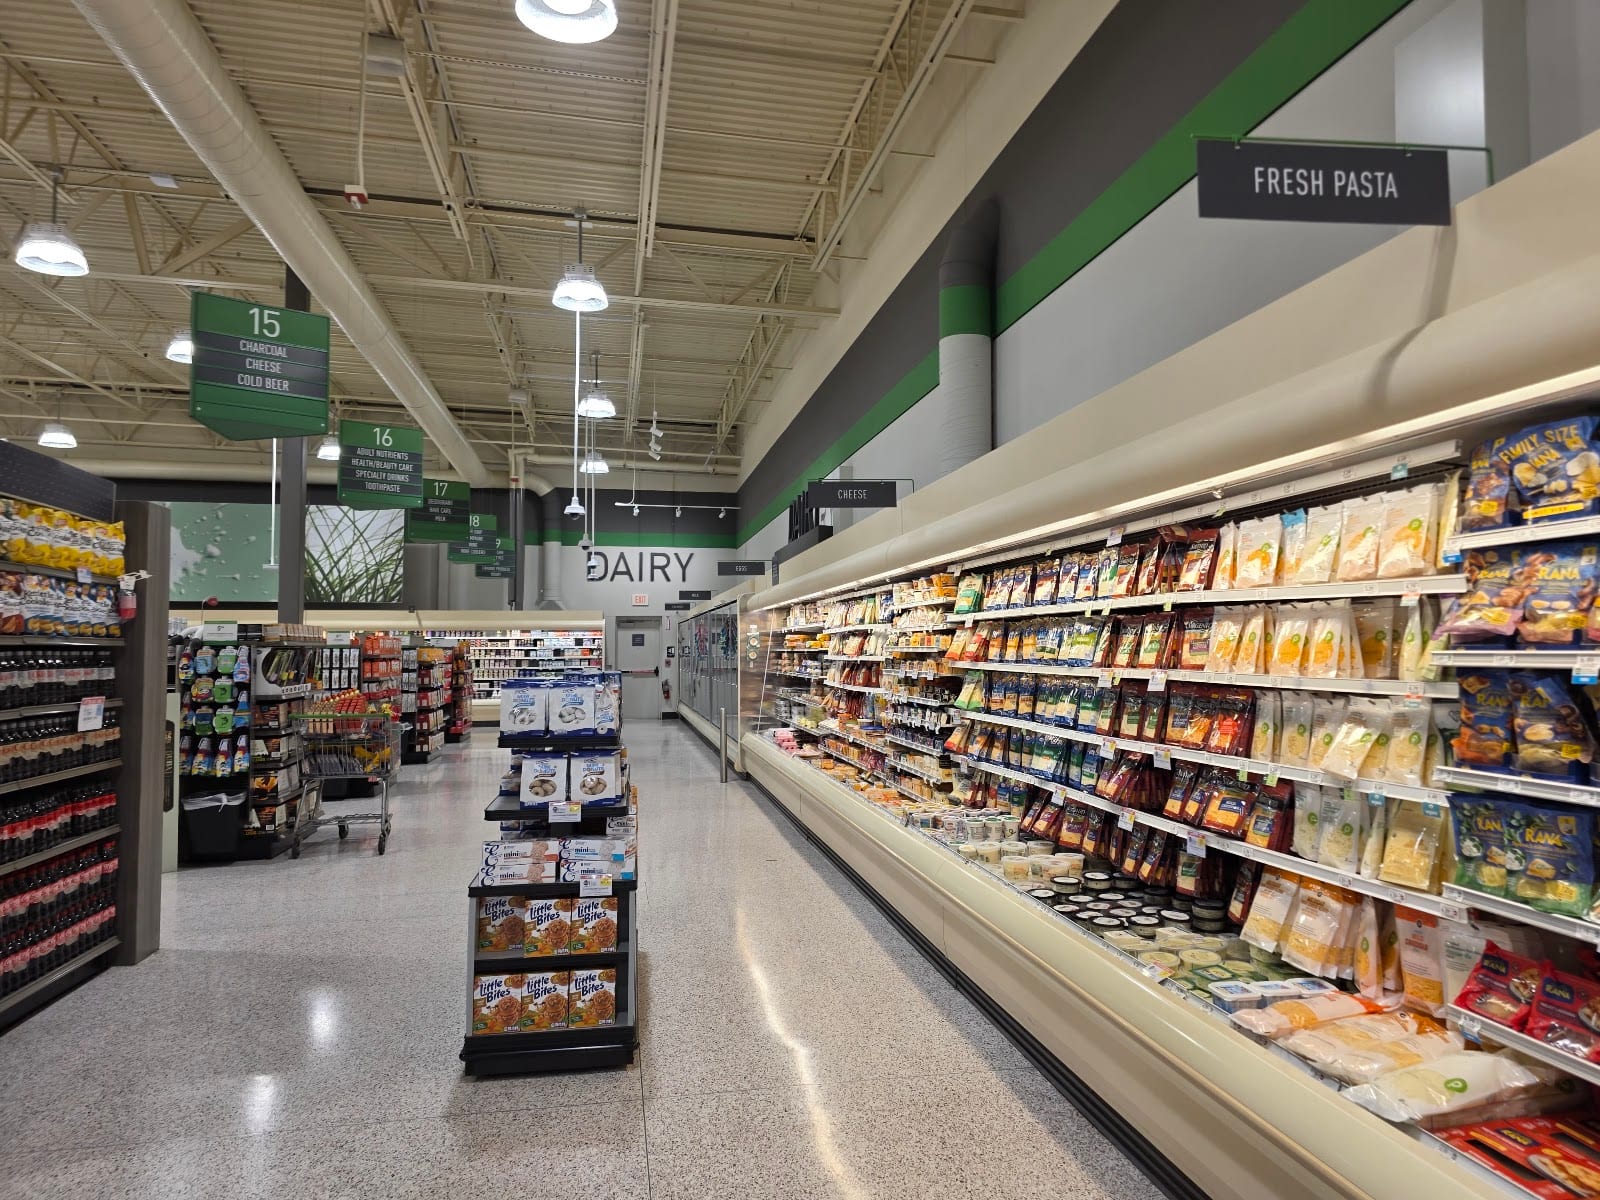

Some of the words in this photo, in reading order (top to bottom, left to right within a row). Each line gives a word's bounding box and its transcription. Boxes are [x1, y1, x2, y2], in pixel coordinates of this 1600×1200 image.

[1254, 167, 1324, 196] FRESH
[1333, 170, 1399, 199] PASTA
[249, 307, 281, 338] 15
[239, 339, 288, 358] CHARCOAL
[245, 358, 282, 374] CHEESE
[237, 373, 262, 387] COLD
[265, 377, 289, 391] BEER
[373, 427, 393, 447] 16
[1543, 424, 1579, 443] SIZE
[356, 448, 375, 457] ADULT
[376, 450, 409, 461] NUTRIENTS
[351, 458, 397, 470] HEALTH/BEAUTY
[398, 463, 414, 472] CARE
[355, 470, 386, 480] SPECIALTY
[387, 473, 409, 482] DRINKS
[365, 482, 401, 493] TOOTHPASTE
[433, 482, 448, 497] 17
[837, 489, 868, 500] CHEESE
[469, 515, 480, 527] 18
[586, 551, 694, 582] DAIRY
[1538, 566, 1581, 580] RANA
[634, 595, 646, 604] EXIT
[1477, 816, 1503, 832] RAN
[1525, 828, 1563, 847] RANA
[503, 850, 519, 858] mini
[484, 898, 507, 917] Little
[491, 907, 515, 922] Bites
[530, 902, 553, 920] Little
[577, 902, 600, 919] Little
[536, 911, 560, 926] Bites
[584, 909, 607, 925] Bites
[480, 980, 503, 997] Little
[526, 976, 550, 993] Little
[574, 973, 597, 990] Little
[581, 981, 605, 997] Bites
[486, 988, 511, 1003] Bites
[533, 984, 557, 1000] Bites
[1544, 984, 1571, 1001] RANA
